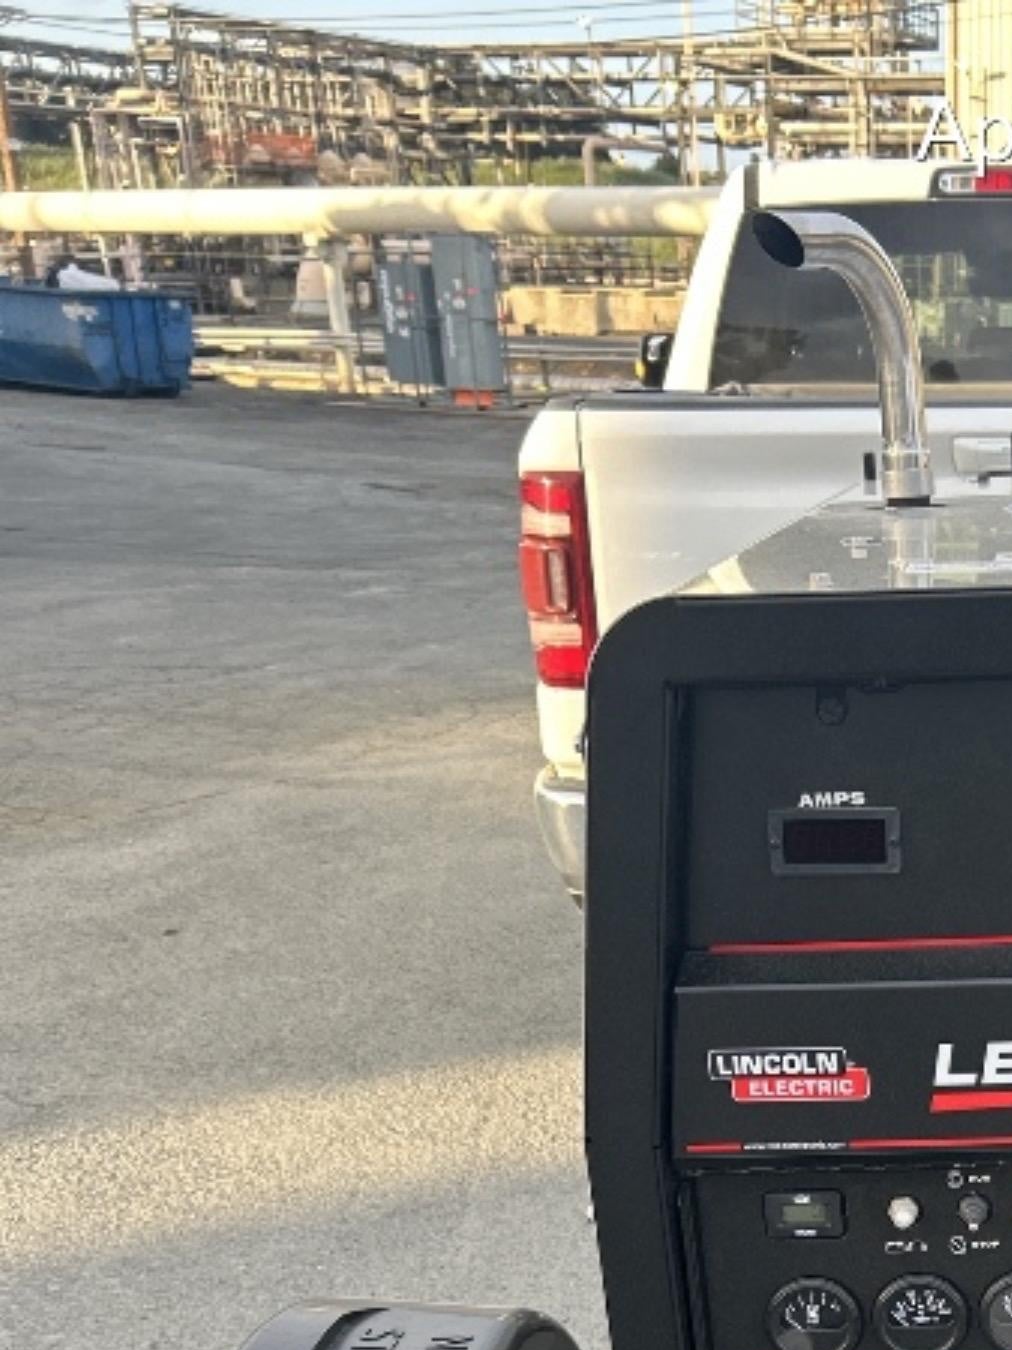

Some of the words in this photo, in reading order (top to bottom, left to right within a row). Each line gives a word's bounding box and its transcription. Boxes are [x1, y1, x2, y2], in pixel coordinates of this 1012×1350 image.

[797, 790, 866, 809] AMPS
[715, 1052, 839, 1076] LINCOLN
[748, 1079, 854, 1097] ELECTRIC
